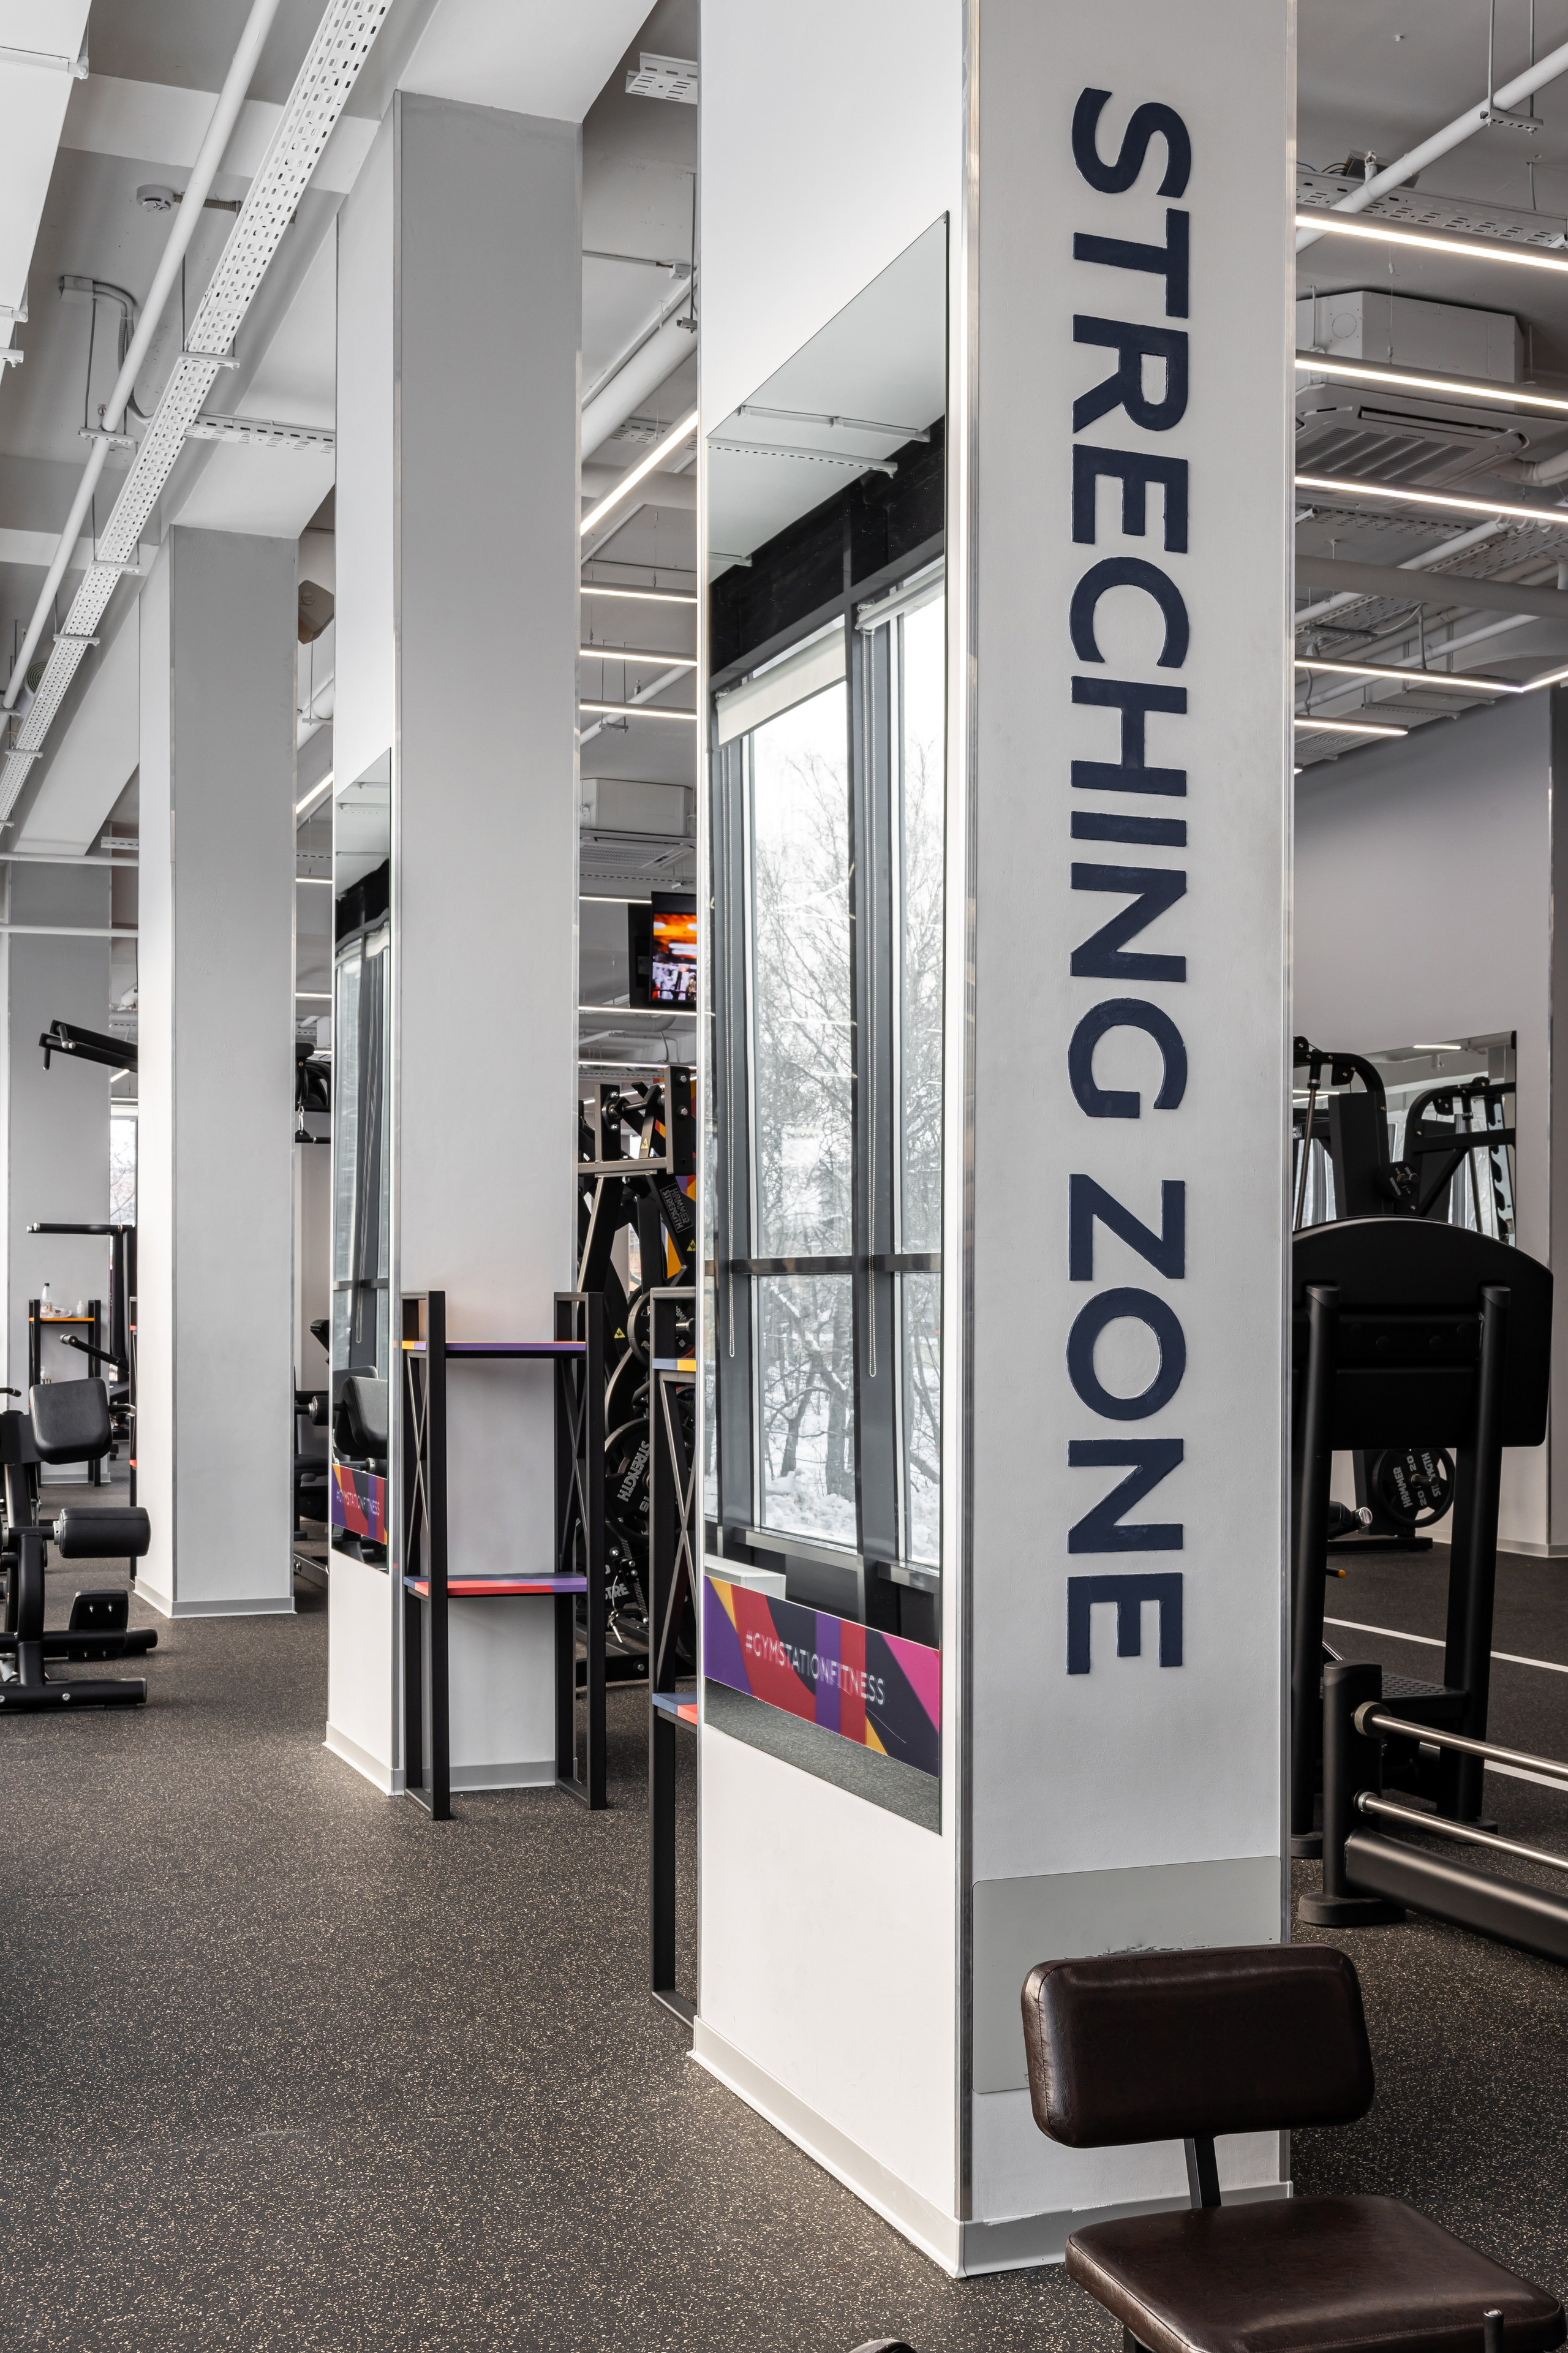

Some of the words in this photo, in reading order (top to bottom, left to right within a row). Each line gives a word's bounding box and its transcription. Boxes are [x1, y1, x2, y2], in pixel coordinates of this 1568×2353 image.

[1067, 87, 1192, 1119] STRECHING
[662, 1189, 684, 1229] STRENGTH
[671, 1187, 690, 1224] HAMMER
[1066, 1173, 1187, 1675] ZONE
[617, 1440, 650, 1503] STRENGTH
[1406, 1455, 1417, 1472] 20
[1392, 1465, 1414, 1509] HAMMER
[1417, 1490, 1428, 1507] 20
[745, 1629, 886, 1706] #GYMSTATIONFITNESS
